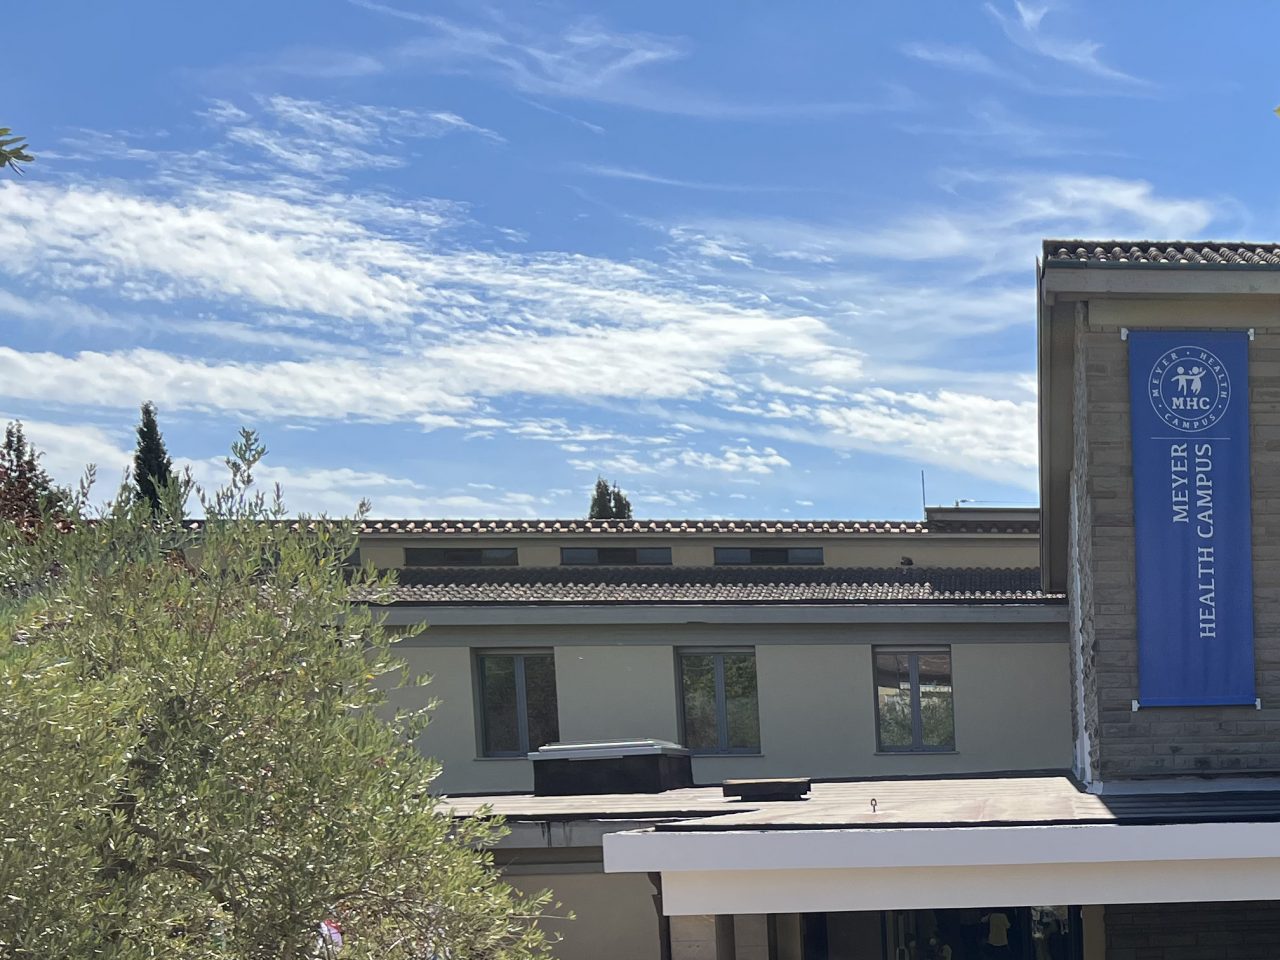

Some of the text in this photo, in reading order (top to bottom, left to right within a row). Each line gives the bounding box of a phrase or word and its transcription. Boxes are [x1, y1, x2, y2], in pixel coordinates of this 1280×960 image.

[1152, 352, 1228, 429] MEYER HEALTH CAMPUS
[1172, 397, 1210, 410] MHC
[1171, 443, 1189, 523] MEYER
[1195, 443, 1216, 638] HEALTH CAMPUS
